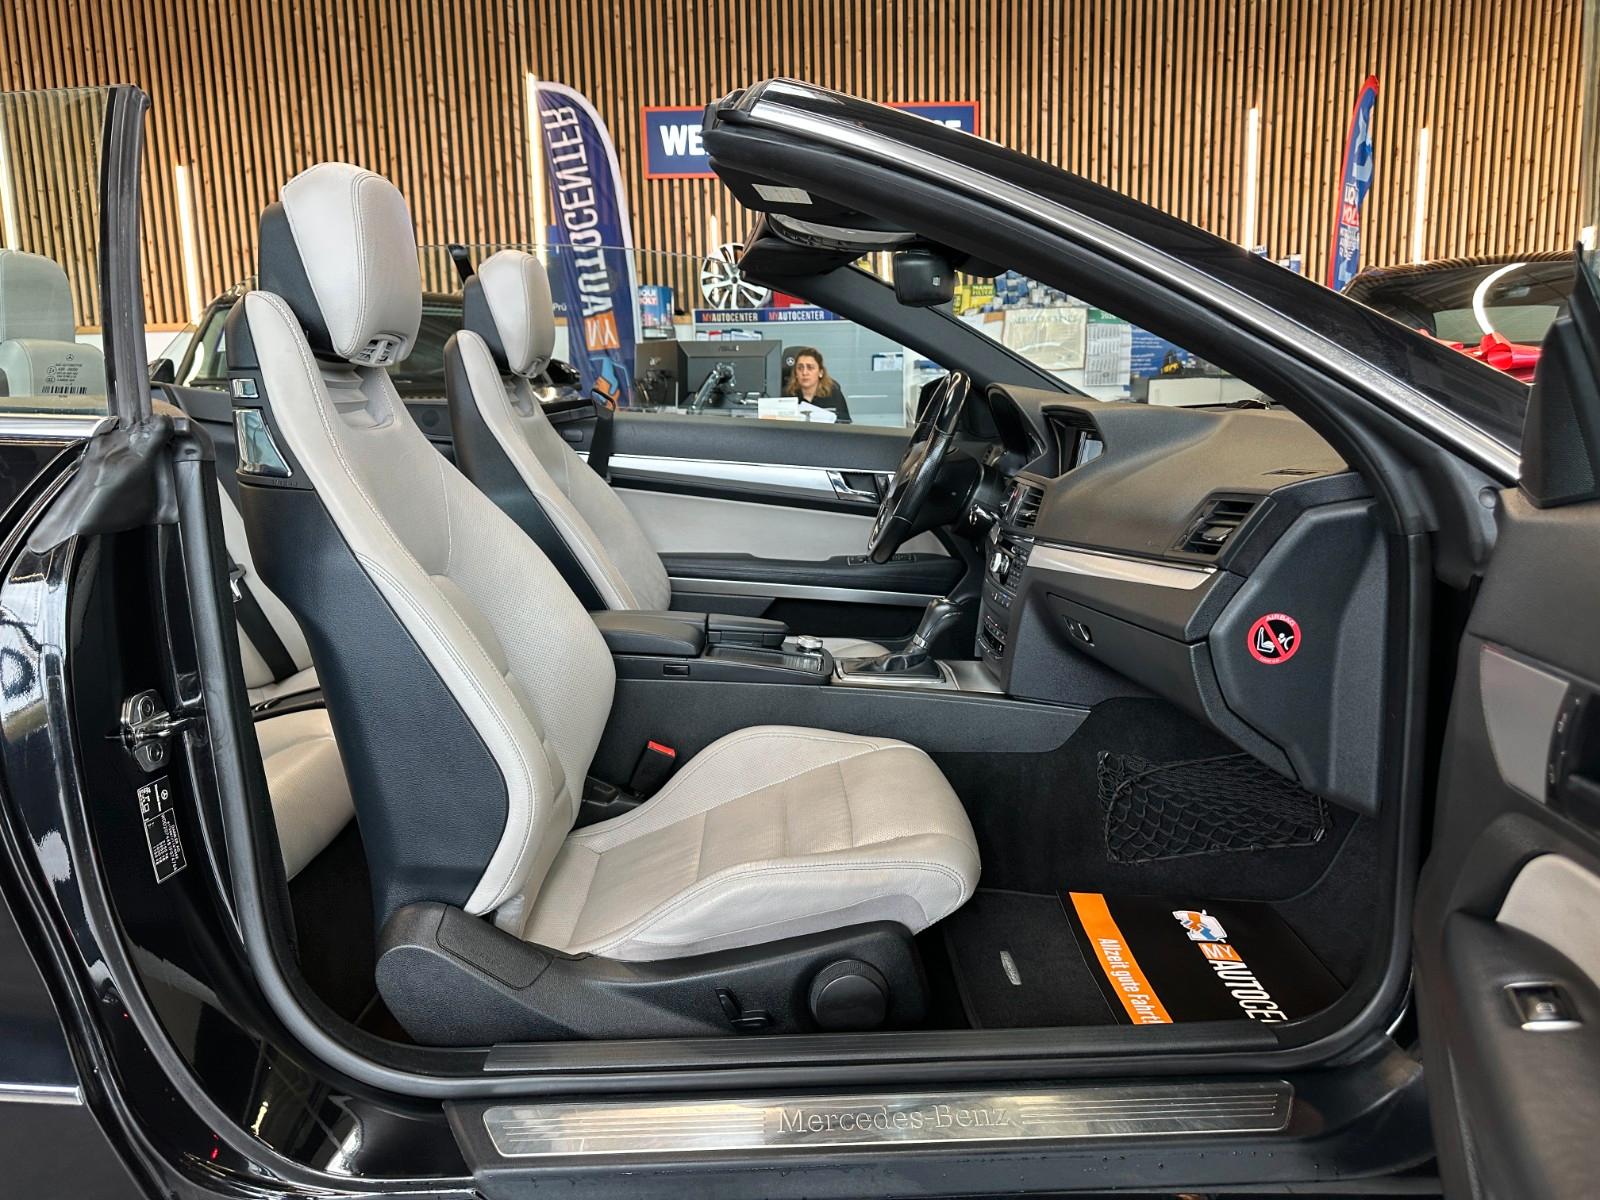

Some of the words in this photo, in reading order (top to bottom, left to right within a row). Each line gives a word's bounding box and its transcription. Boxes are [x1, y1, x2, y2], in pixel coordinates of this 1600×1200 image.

[659, 125, 710, 157] WE
[1266, 613, 1297, 627] AIRBAG
[1098, 937, 1130, 969] Allzeit
[1201, 943, 1234, 959] MY
[1110, 970, 1141, 992] gute
[1208, 960, 1289, 1023] AUTOCE
[777, 1103, 1011, 1133] Mercedes-Benz
